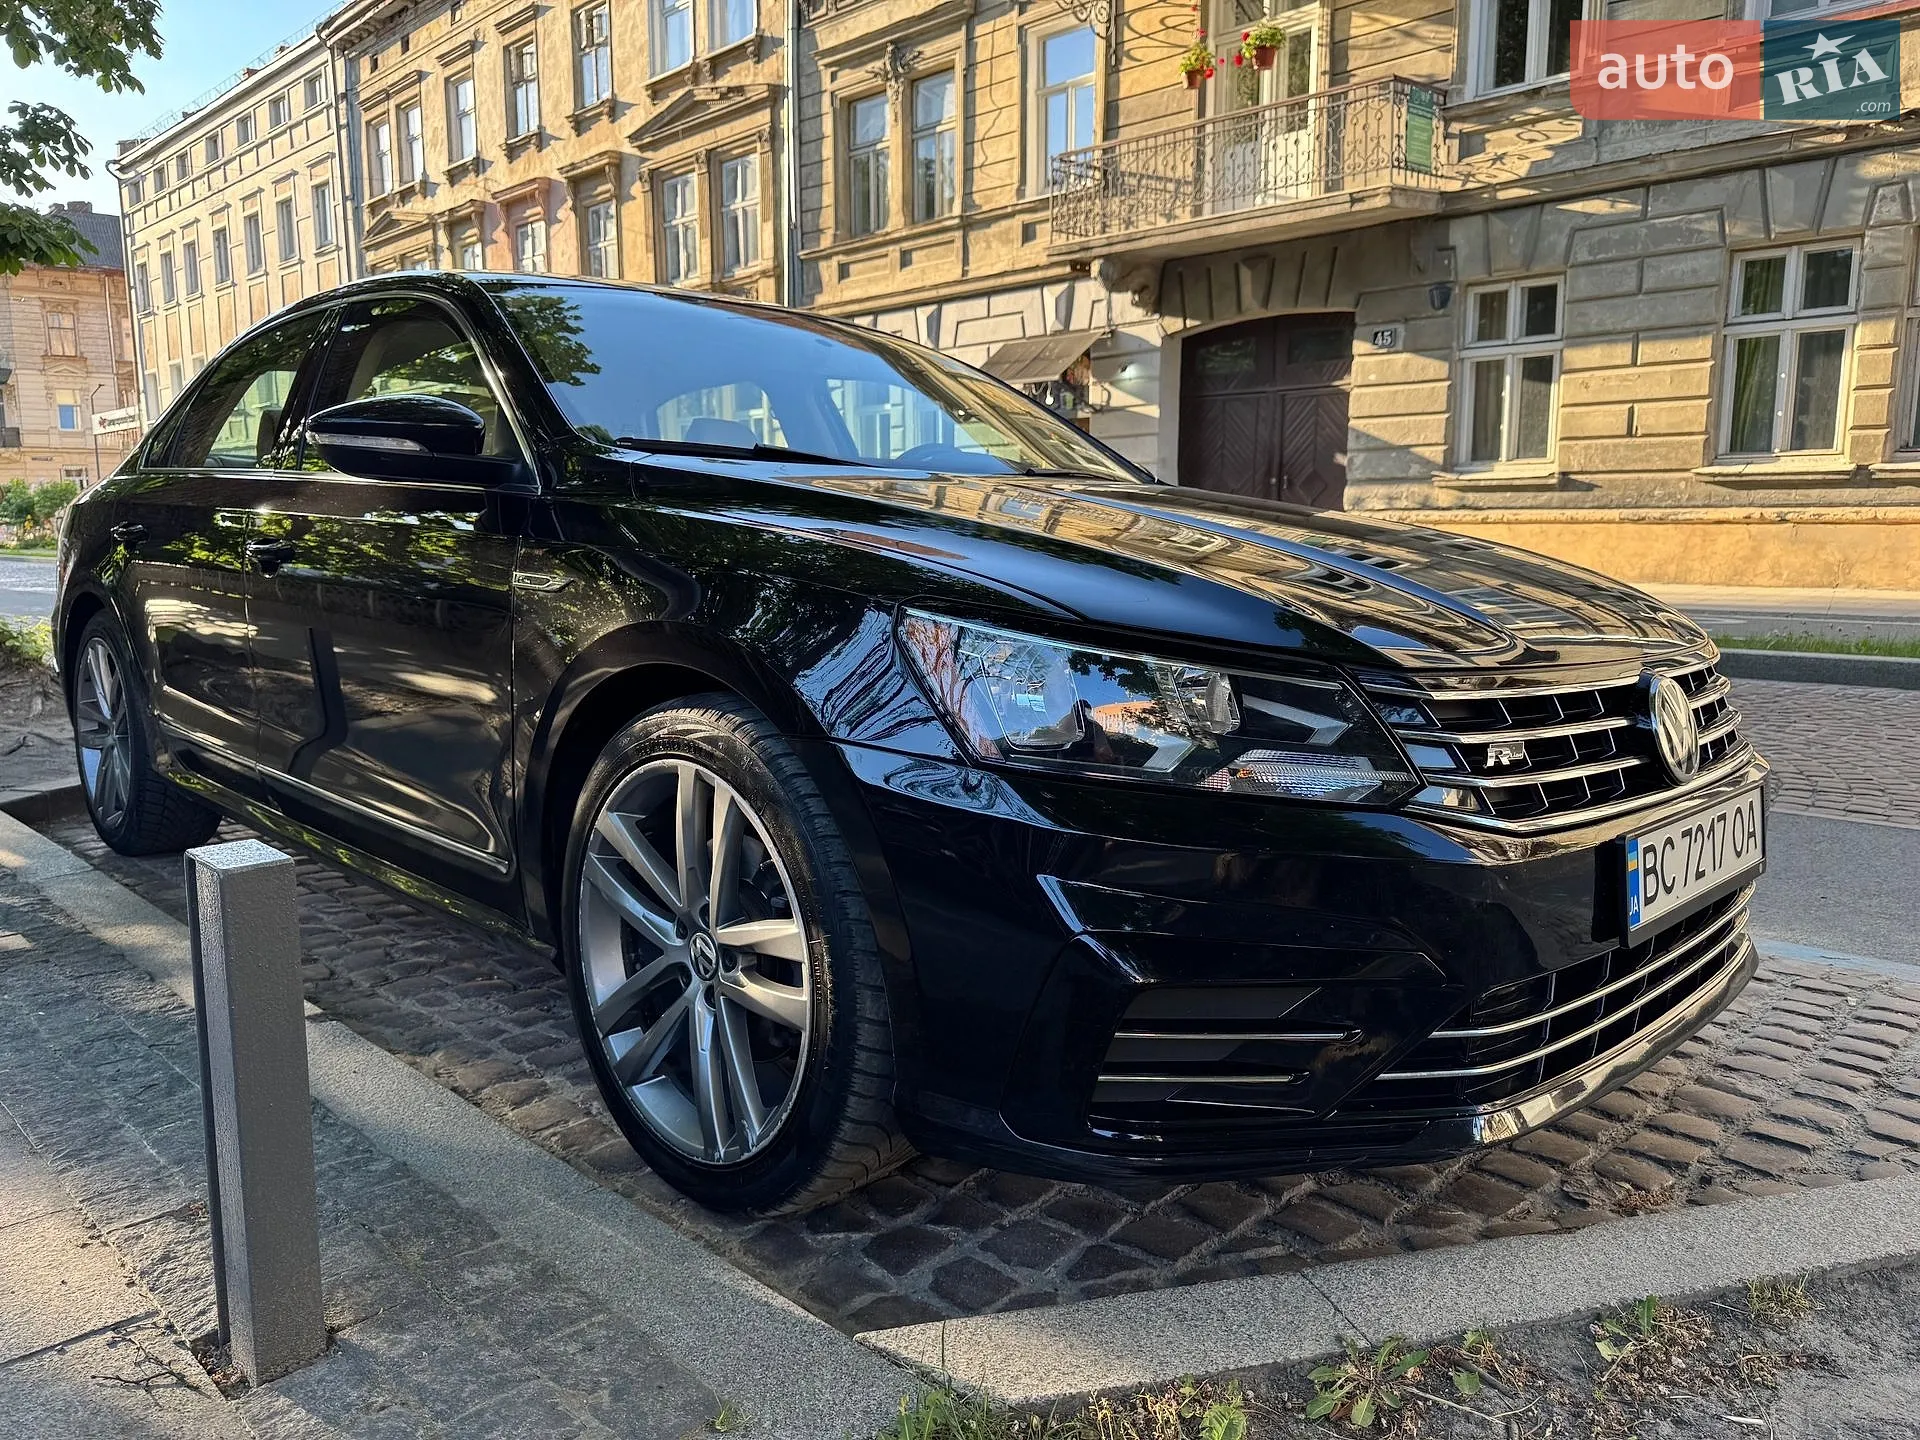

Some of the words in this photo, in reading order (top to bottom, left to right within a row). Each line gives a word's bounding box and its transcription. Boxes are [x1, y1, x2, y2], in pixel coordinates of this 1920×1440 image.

[1374, 331, 1392, 346] 45
[1642, 836, 1675, 907] BC
[1681, 811, 1727, 887] 7217
[1732, 799, 1758, 859] OA
